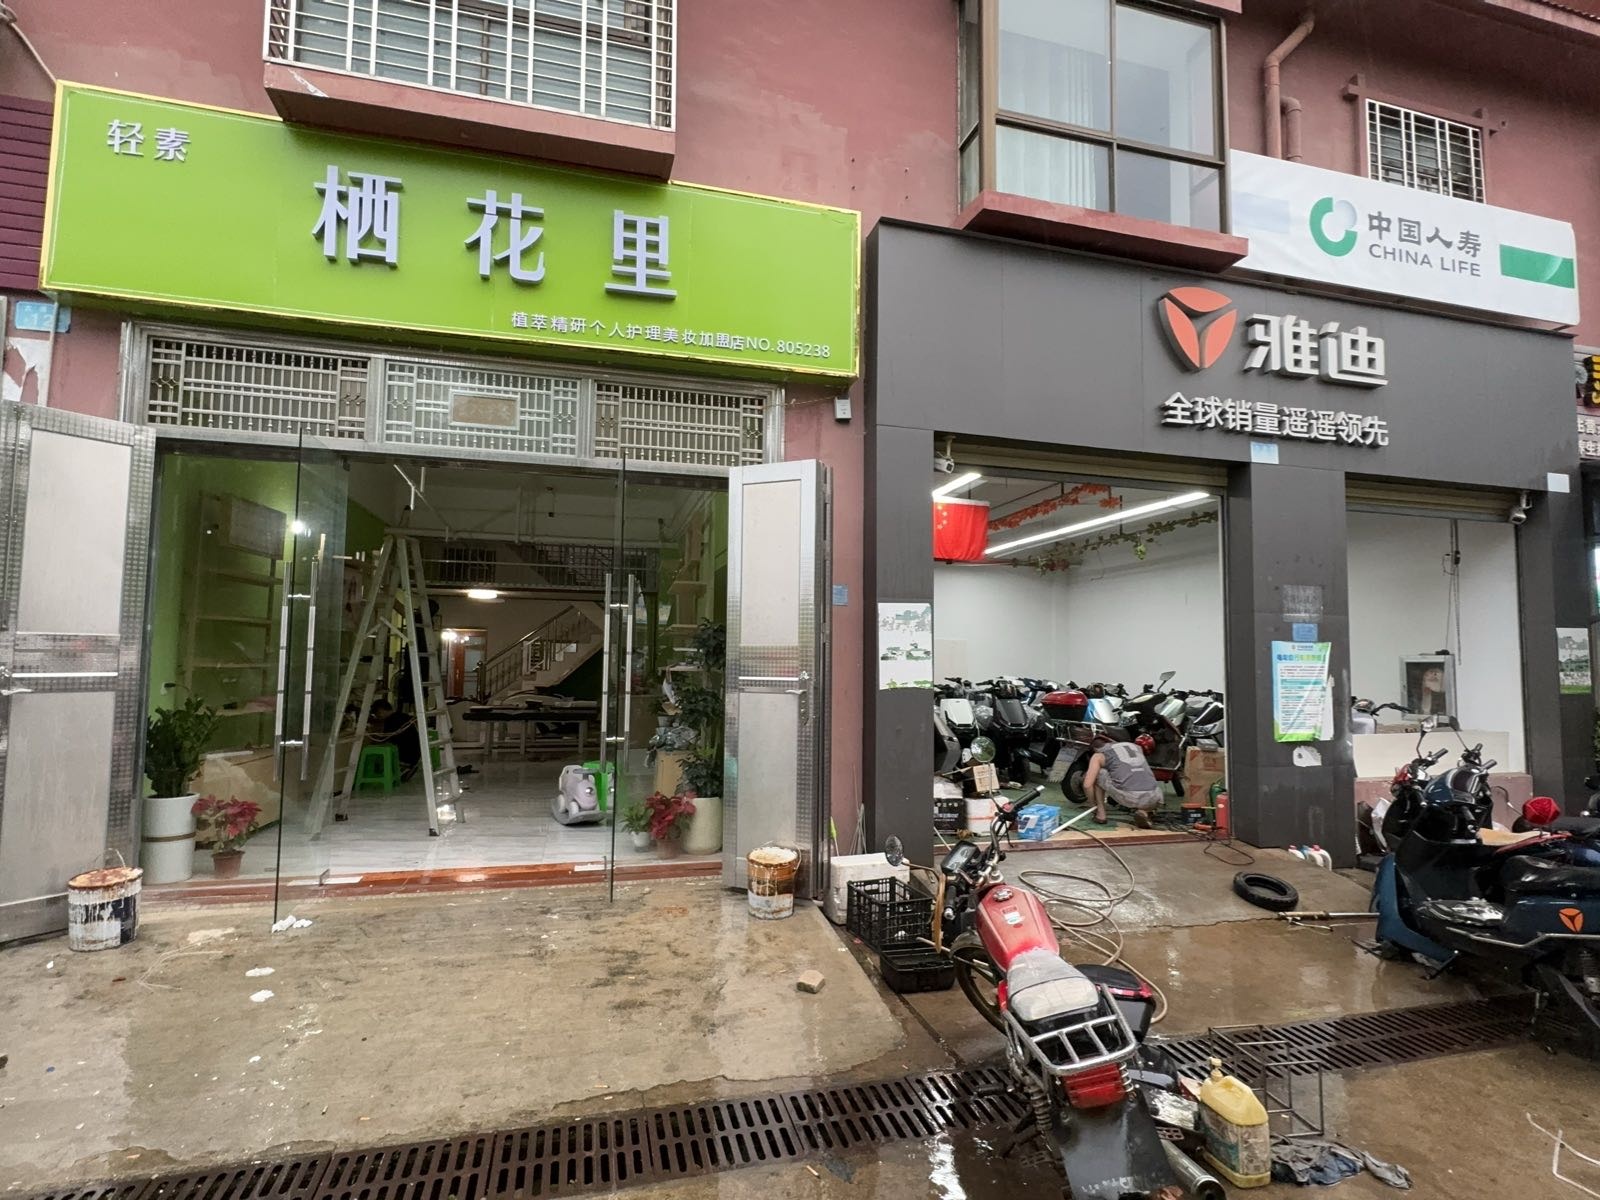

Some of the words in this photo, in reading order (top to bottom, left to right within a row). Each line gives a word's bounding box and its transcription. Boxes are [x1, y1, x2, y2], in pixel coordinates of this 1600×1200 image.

[107, 119, 191, 163] 轻素
[312, 164, 678, 301] 栖花里
[1367, 210, 1482, 259] 中国人寿
[1368, 242, 1433, 269] CHINA
[1440, 257, 1482, 278] LIFE
[1243, 312, 1389, 388] 雅迪
[1162, 391, 1390, 447] 全球销量遥遥领先
